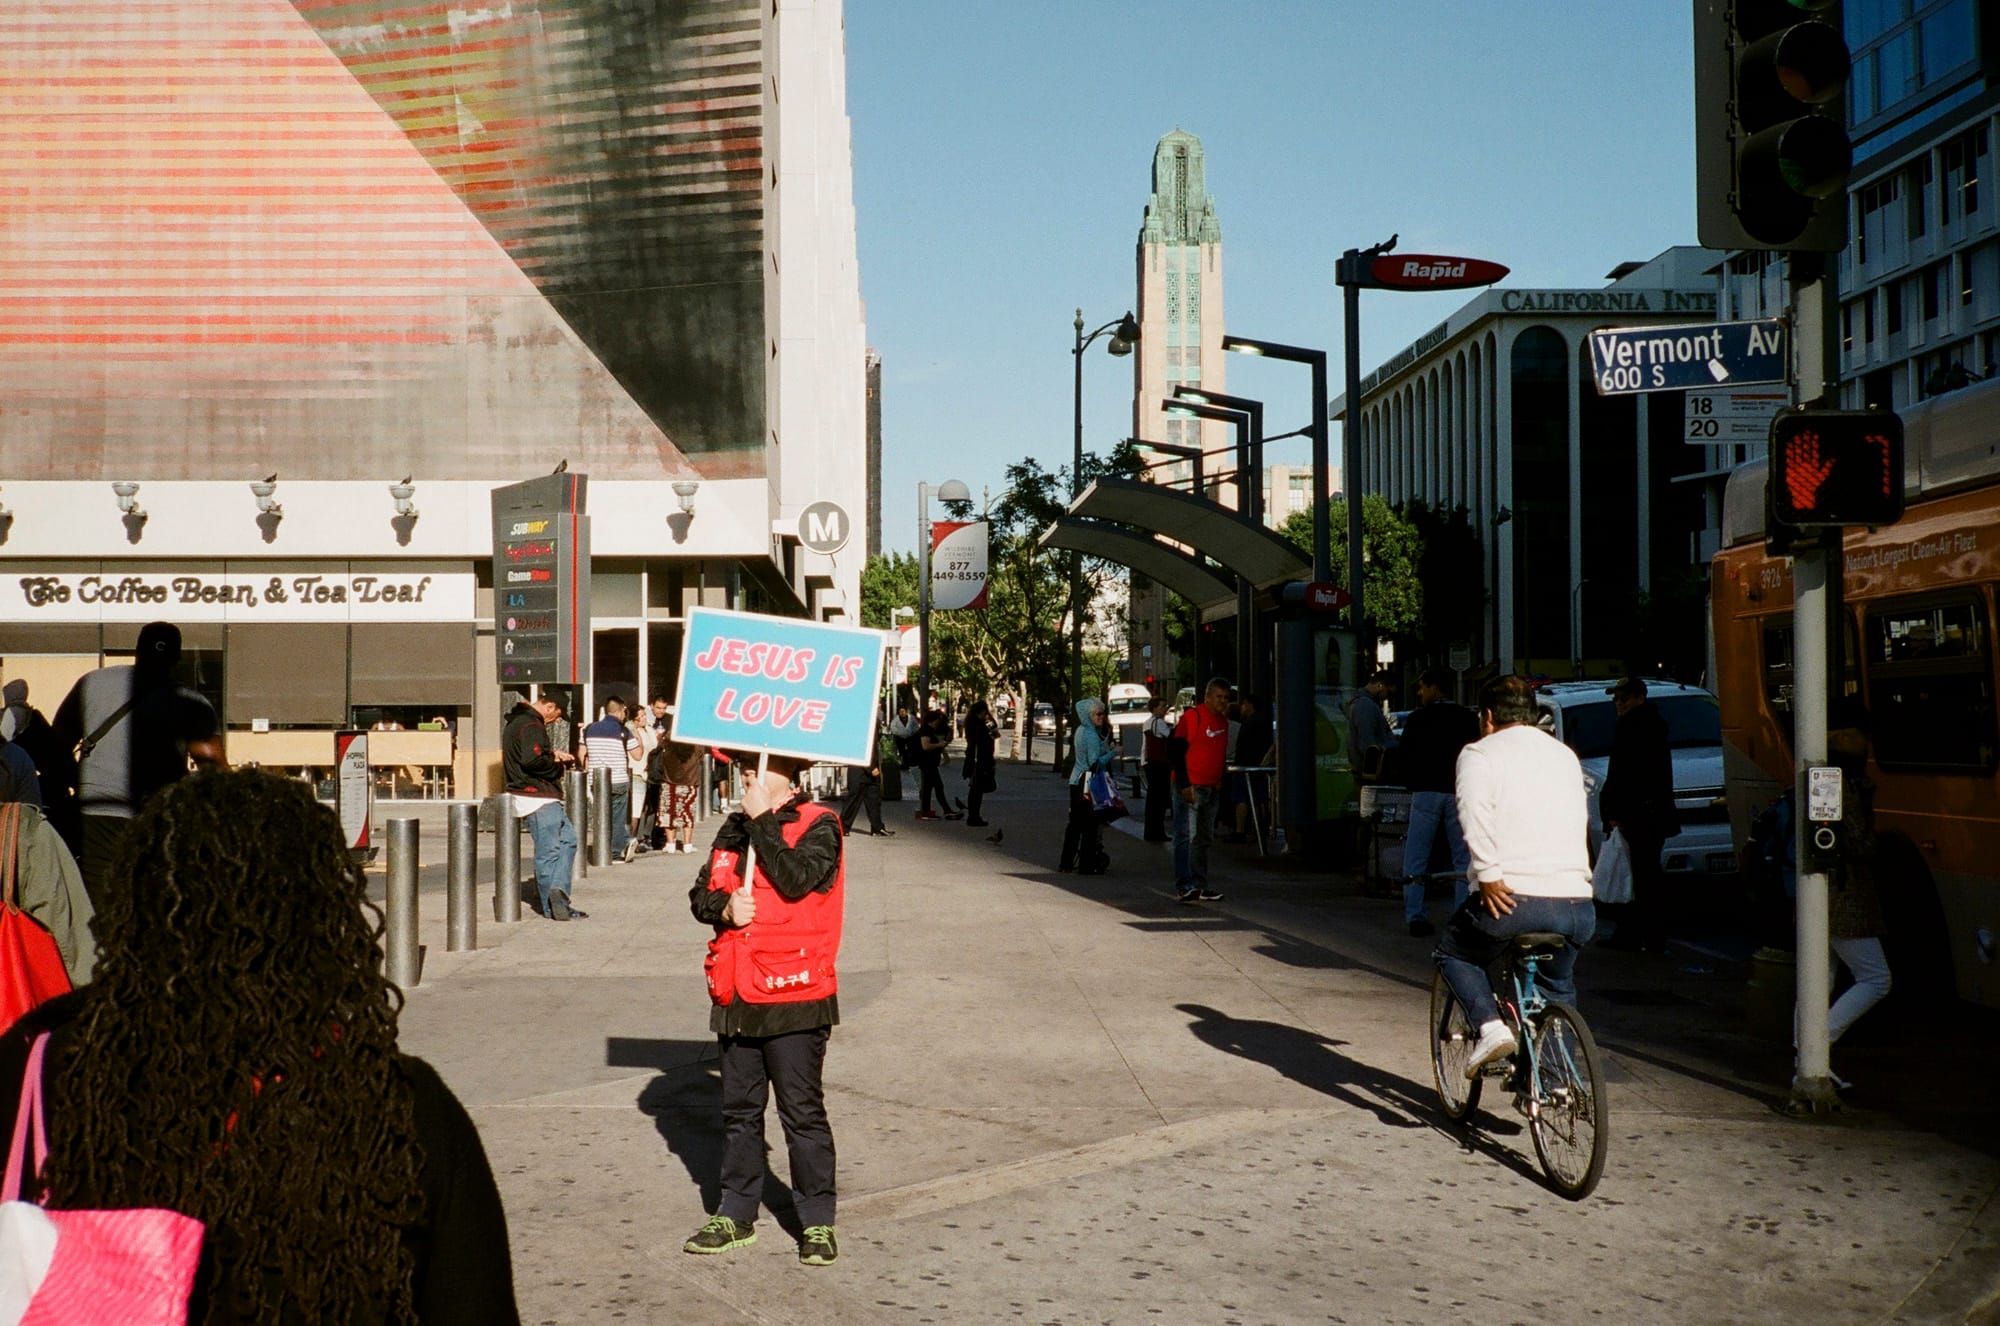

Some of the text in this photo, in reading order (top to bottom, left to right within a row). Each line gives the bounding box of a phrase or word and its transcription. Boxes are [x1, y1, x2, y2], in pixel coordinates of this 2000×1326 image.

[1402, 261, 1467, 280] Rapid
[1501, 290, 1650, 312] CALIFORNIA
[1597, 324, 1781, 368] Vermont Av
[1601, 365, 1666, 390] 600 S
[1690, 397, 1713, 415] 18
[1689, 419, 1719, 437] 20
[510, 519, 549, 536] SUBWAY
[808, 512, 840, 542] M
[1846, 532, 1977, 571] Nation's Largest Clean-Air Fleet
[933, 571, 986, 581] 449-8559
[949, 561, 970, 571] 877
[1760, 568, 1782, 590] 3926
[19, 576, 432, 608] The Coffee Bean & Tea Leaf
[1315, 589, 1338, 606] Rapid
[695, 635, 864, 690] JESUS IS
[715, 688, 830, 734] LOVE
